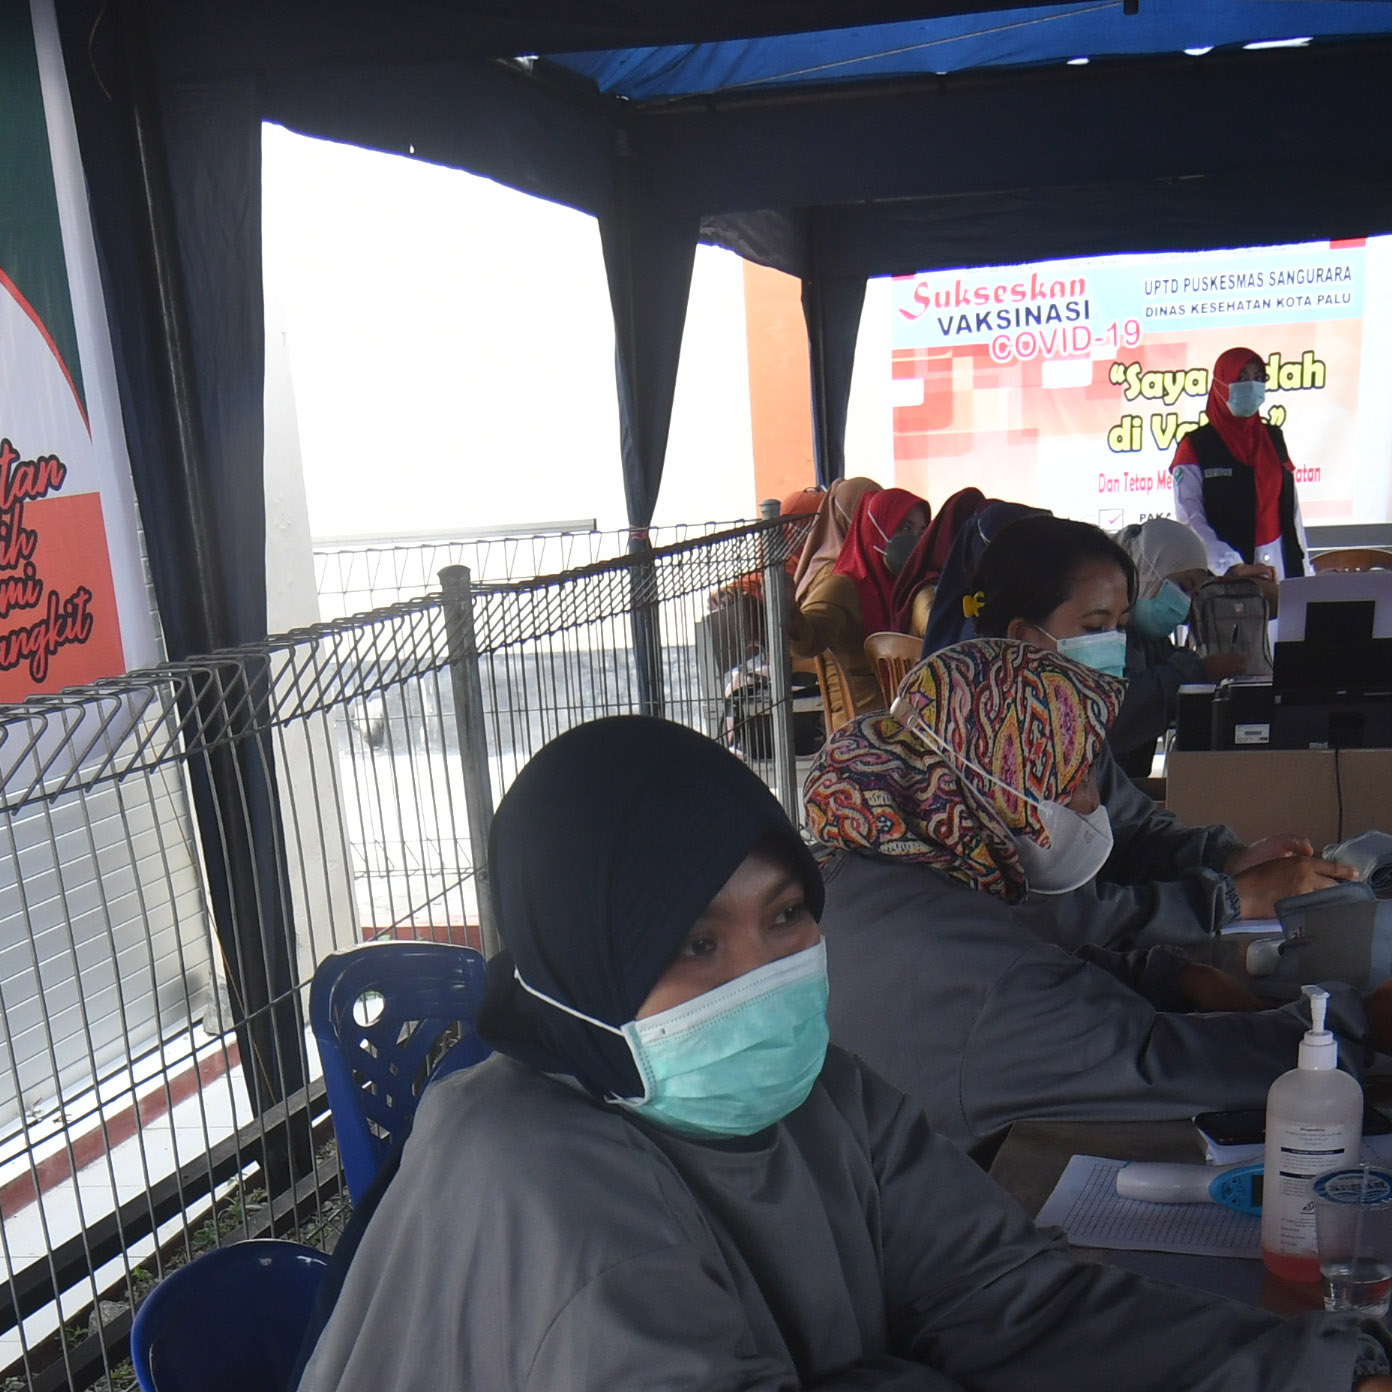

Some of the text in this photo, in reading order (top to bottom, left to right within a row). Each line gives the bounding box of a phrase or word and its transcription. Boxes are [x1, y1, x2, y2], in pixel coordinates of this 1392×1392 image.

[898, 272, 1085, 320] Sukseskan
[1144, 266, 1352, 296] UPTD PUSKESMAS SANGURARA
[937, 300, 1090, 337] VAKSINASI
[1145, 292, 1352, 318] DINAS KESEHATAN KOTA PALU
[990, 318, 1142, 359] COVID-19
[1264, 351, 1326, 391] dah
[1107, 415, 1143, 453] di
[1098, 473, 1120, 493] Dan
[1123, 472, 1153, 494] Tetap
